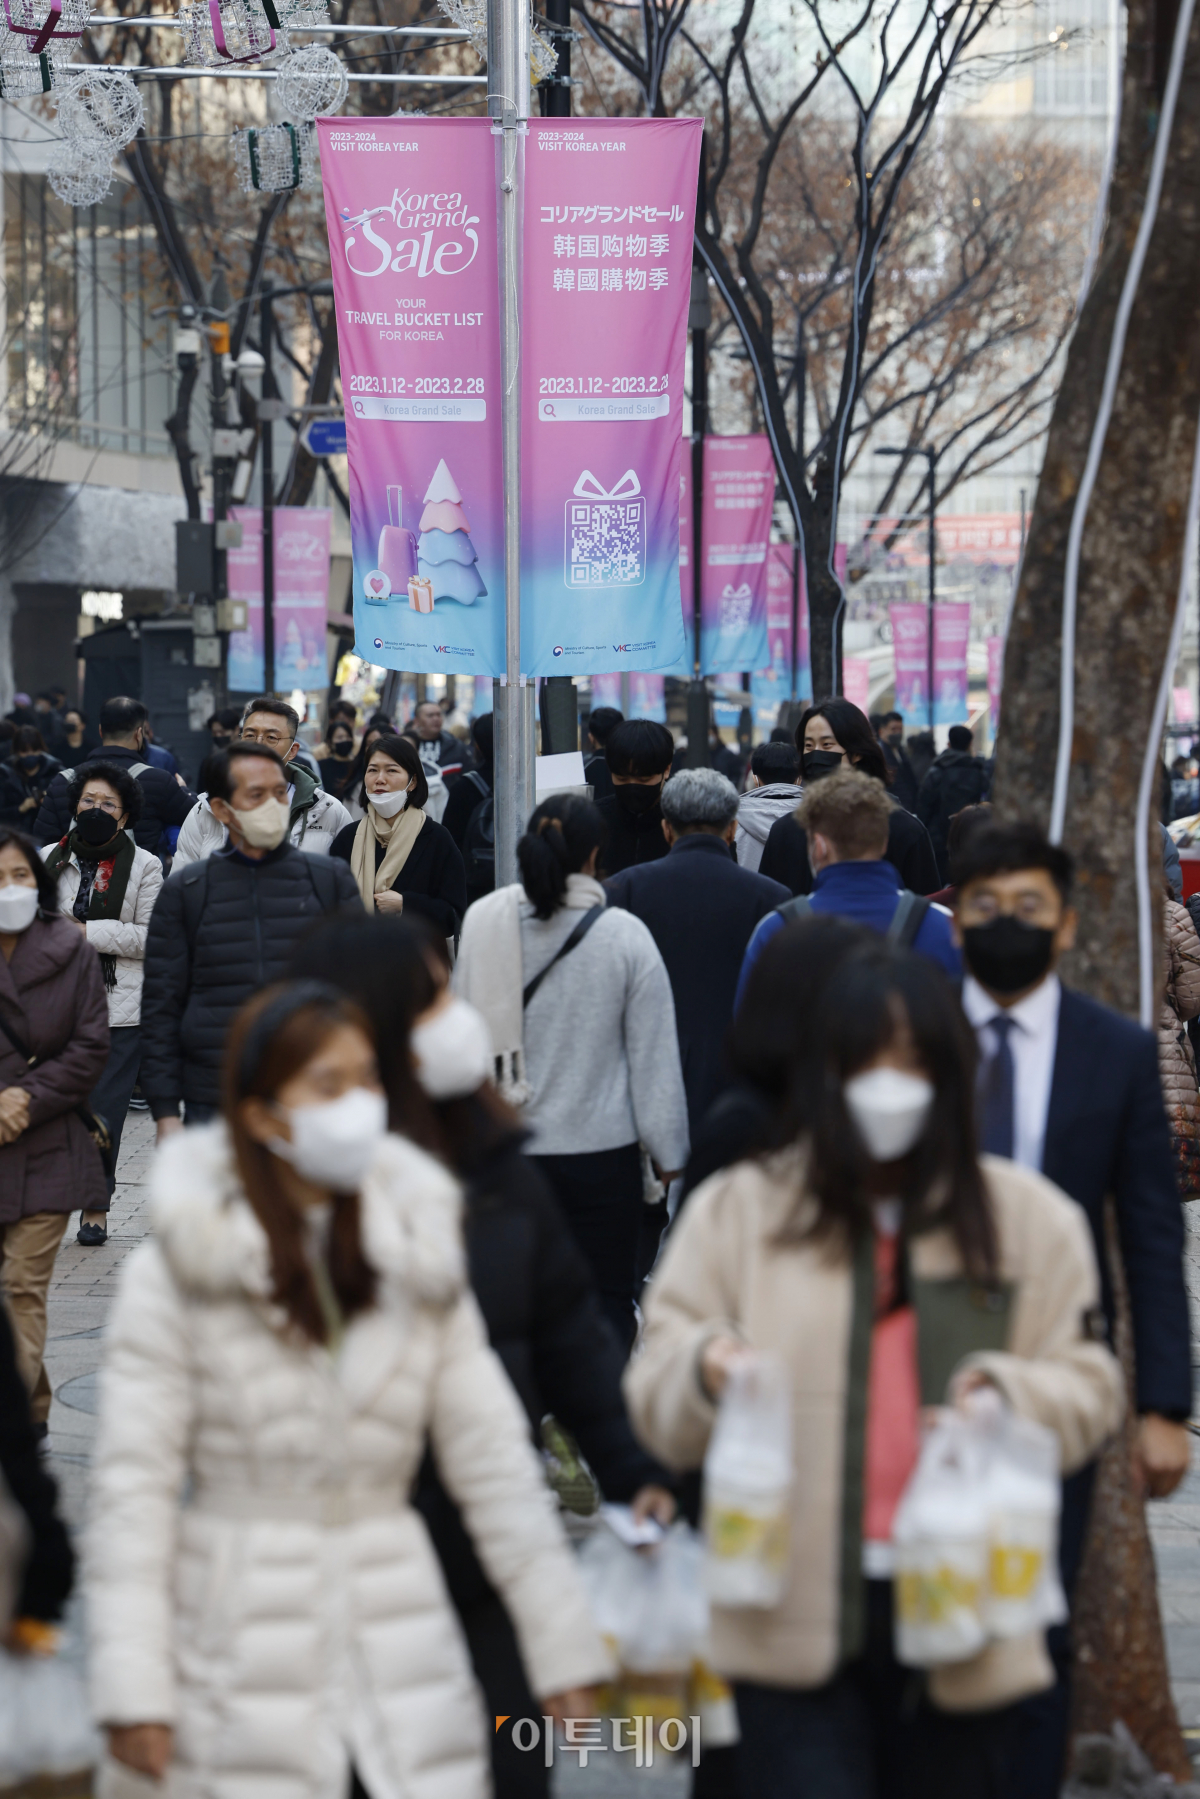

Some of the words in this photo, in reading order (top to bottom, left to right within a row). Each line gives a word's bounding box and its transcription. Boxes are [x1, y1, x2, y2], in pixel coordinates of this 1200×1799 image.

[330, 132, 376, 141] 2023-2024
[538, 132, 584, 141] 2023-2024
[330, 142, 356, 151] VISIT
[358, 142, 392, 152] KOREA
[392, 142, 419, 152] YEAR
[538, 141, 563, 151] VISIT
[566, 142, 599, 151] KOREA
[600, 142, 626, 151] YEAR
[391, 188, 462, 211] Korea
[396, 204, 468, 229] Grand
[540, 205, 684, 223] コリアグランドセール
[345, 206, 479, 278] Sale
[553, 234, 669, 258] 韩国购物季
[553, 267, 668, 292] 韓國購物季
[396, 299, 426, 308] YOUR
[345, 311, 391, 326] TRAVEL
[395, 313, 451, 326] BUCKET
[454, 313, 484, 326] LIST
[379, 330, 401, 340] FOR
[404, 331, 444, 341] KOREA
[384, 405, 409, 415] Korea
[412, 405, 438, 415] Grand
[442, 405, 461, 415] Sale
[578, 405, 605, 415] Korea
[608, 404, 634, 414] Grand
[636, 404, 655, 414] Sale
[433, 645, 451, 654] VKC
[612, 644, 631, 652] VKC
